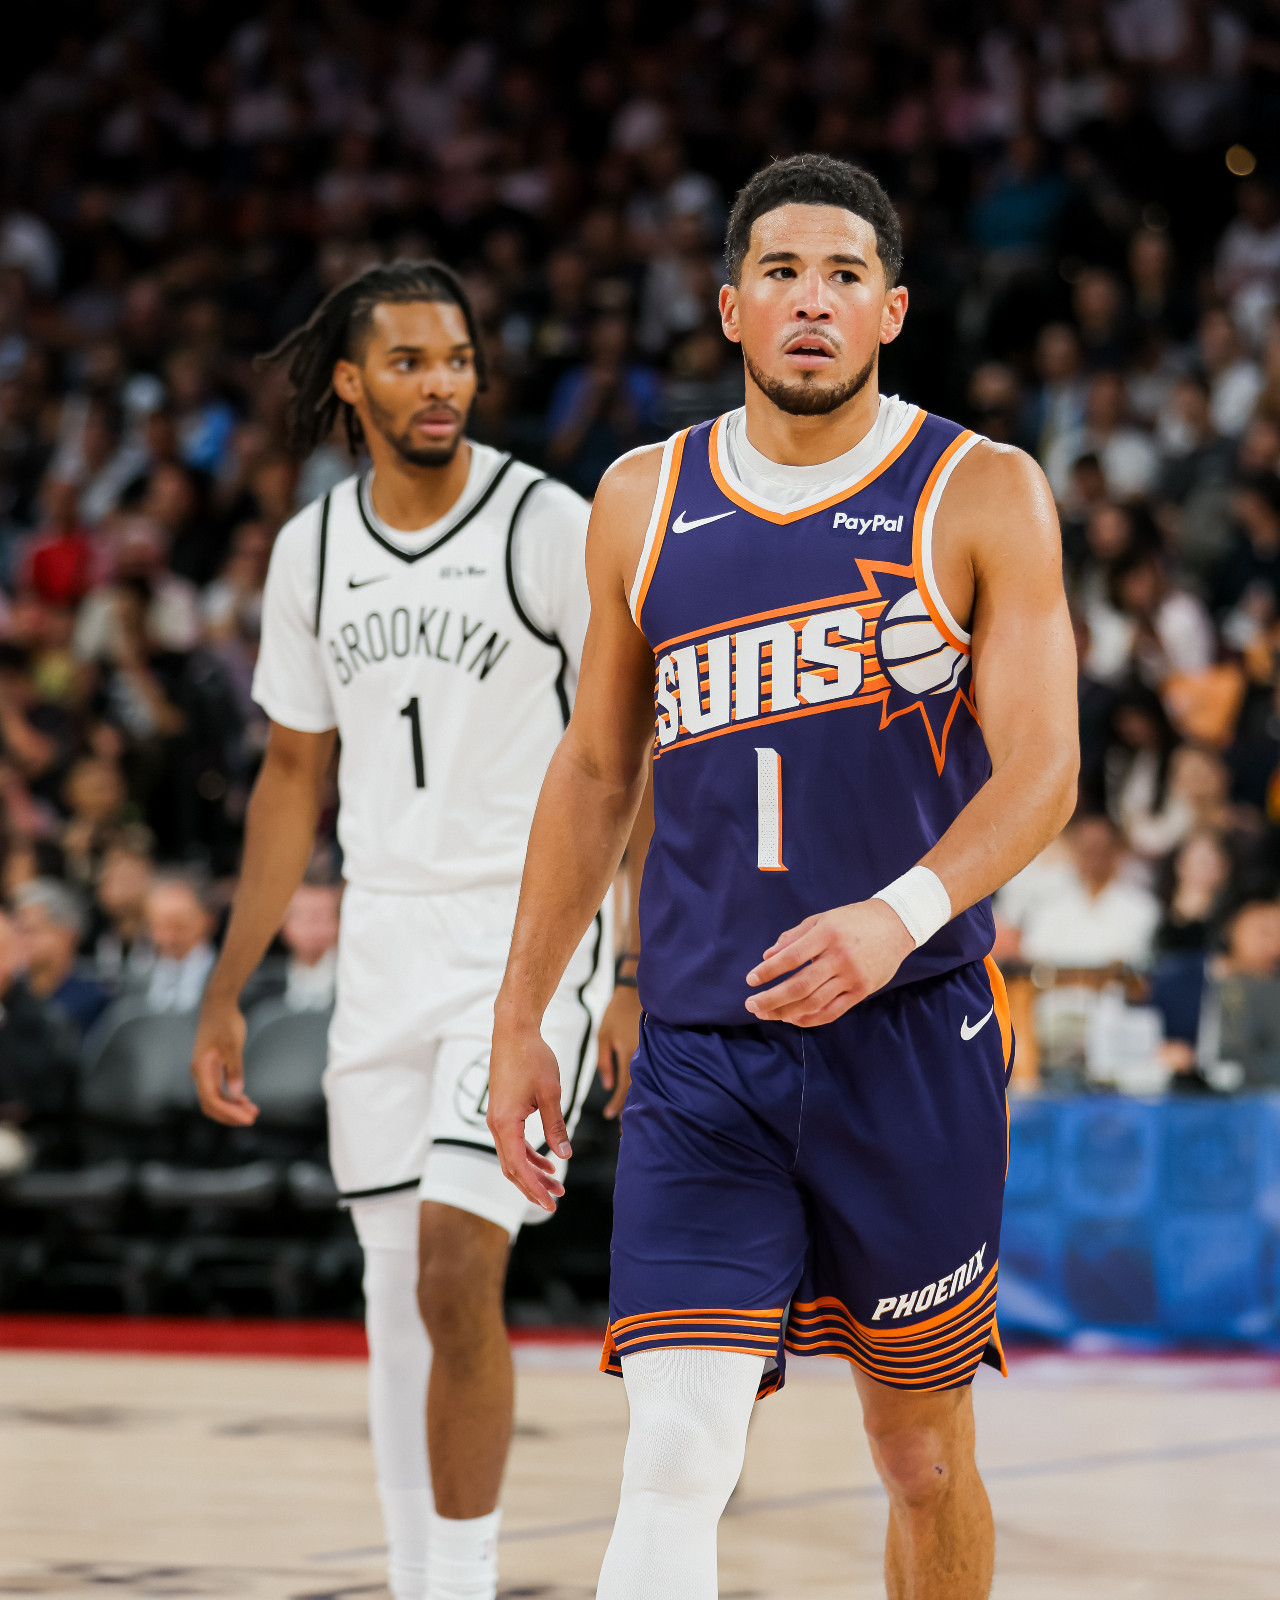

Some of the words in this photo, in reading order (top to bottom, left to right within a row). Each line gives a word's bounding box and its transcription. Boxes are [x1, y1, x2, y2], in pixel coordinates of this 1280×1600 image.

[833, 512, 904, 535] PayPal
[329, 606, 511, 686] BROOKLYN
[399, 697, 426, 788] 1
[755, 747, 788, 872] 1
[871, 1242, 987, 1321] PHOENIX
